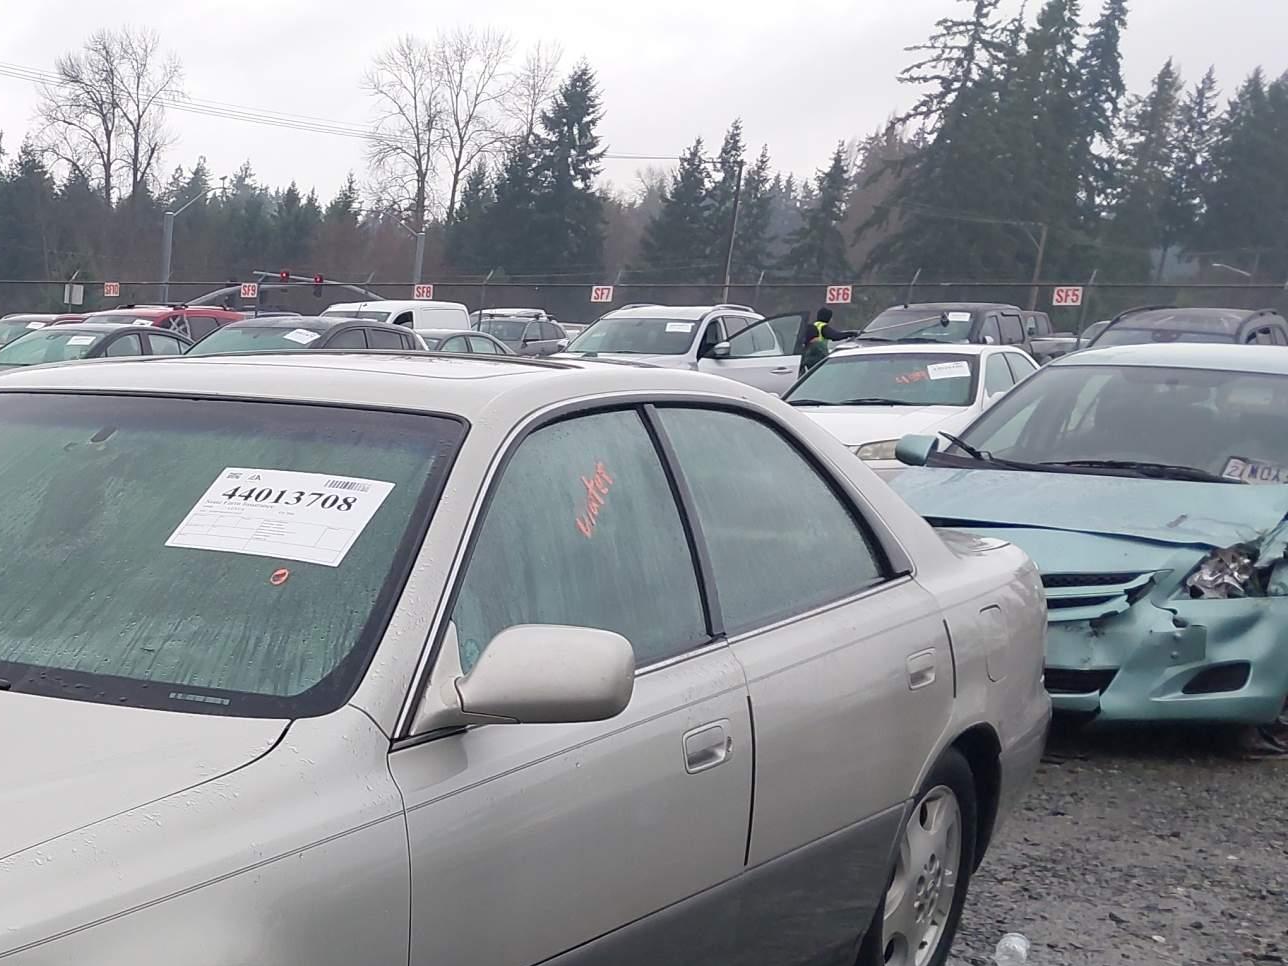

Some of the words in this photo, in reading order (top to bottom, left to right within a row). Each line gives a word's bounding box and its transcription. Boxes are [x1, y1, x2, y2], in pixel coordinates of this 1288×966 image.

[242, 284, 257, 297] SF9
[415, 285, 432, 298] SF8
[593, 287, 611, 300] SF7
[827, 287, 850, 301] SF6
[1055, 288, 1080, 303] SF5
[222, 486, 358, 512] 44013708
